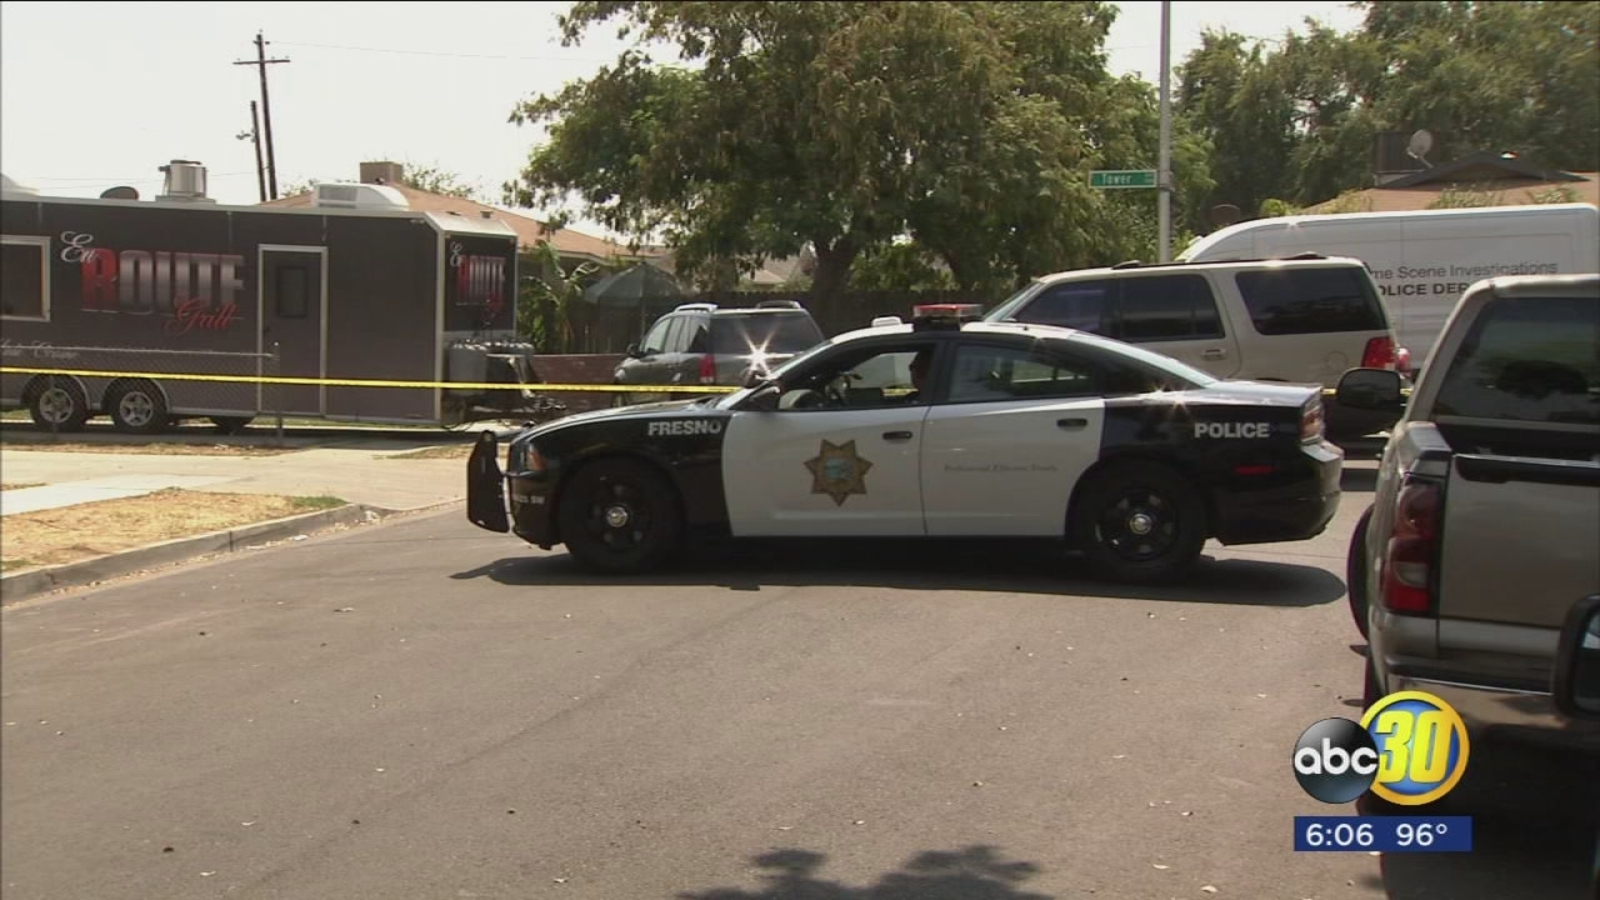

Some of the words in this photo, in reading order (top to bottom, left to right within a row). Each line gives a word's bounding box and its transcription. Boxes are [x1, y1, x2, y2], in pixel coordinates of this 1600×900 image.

[1102, 173, 1132, 185] Tower
[60, 231, 96, 263] En
[1398, 265, 1447, 279] Scene
[1450, 261, 1559, 277] Investigations
[80, 248, 244, 319] ROUTE
[1379, 283, 1428, 297] OLICE
[1432, 282, 1469, 296] DEP
[163, 300, 237, 336] Grill
[648, 420, 722, 436] FRESNO
[1194, 422, 1270, 439] POLICE
